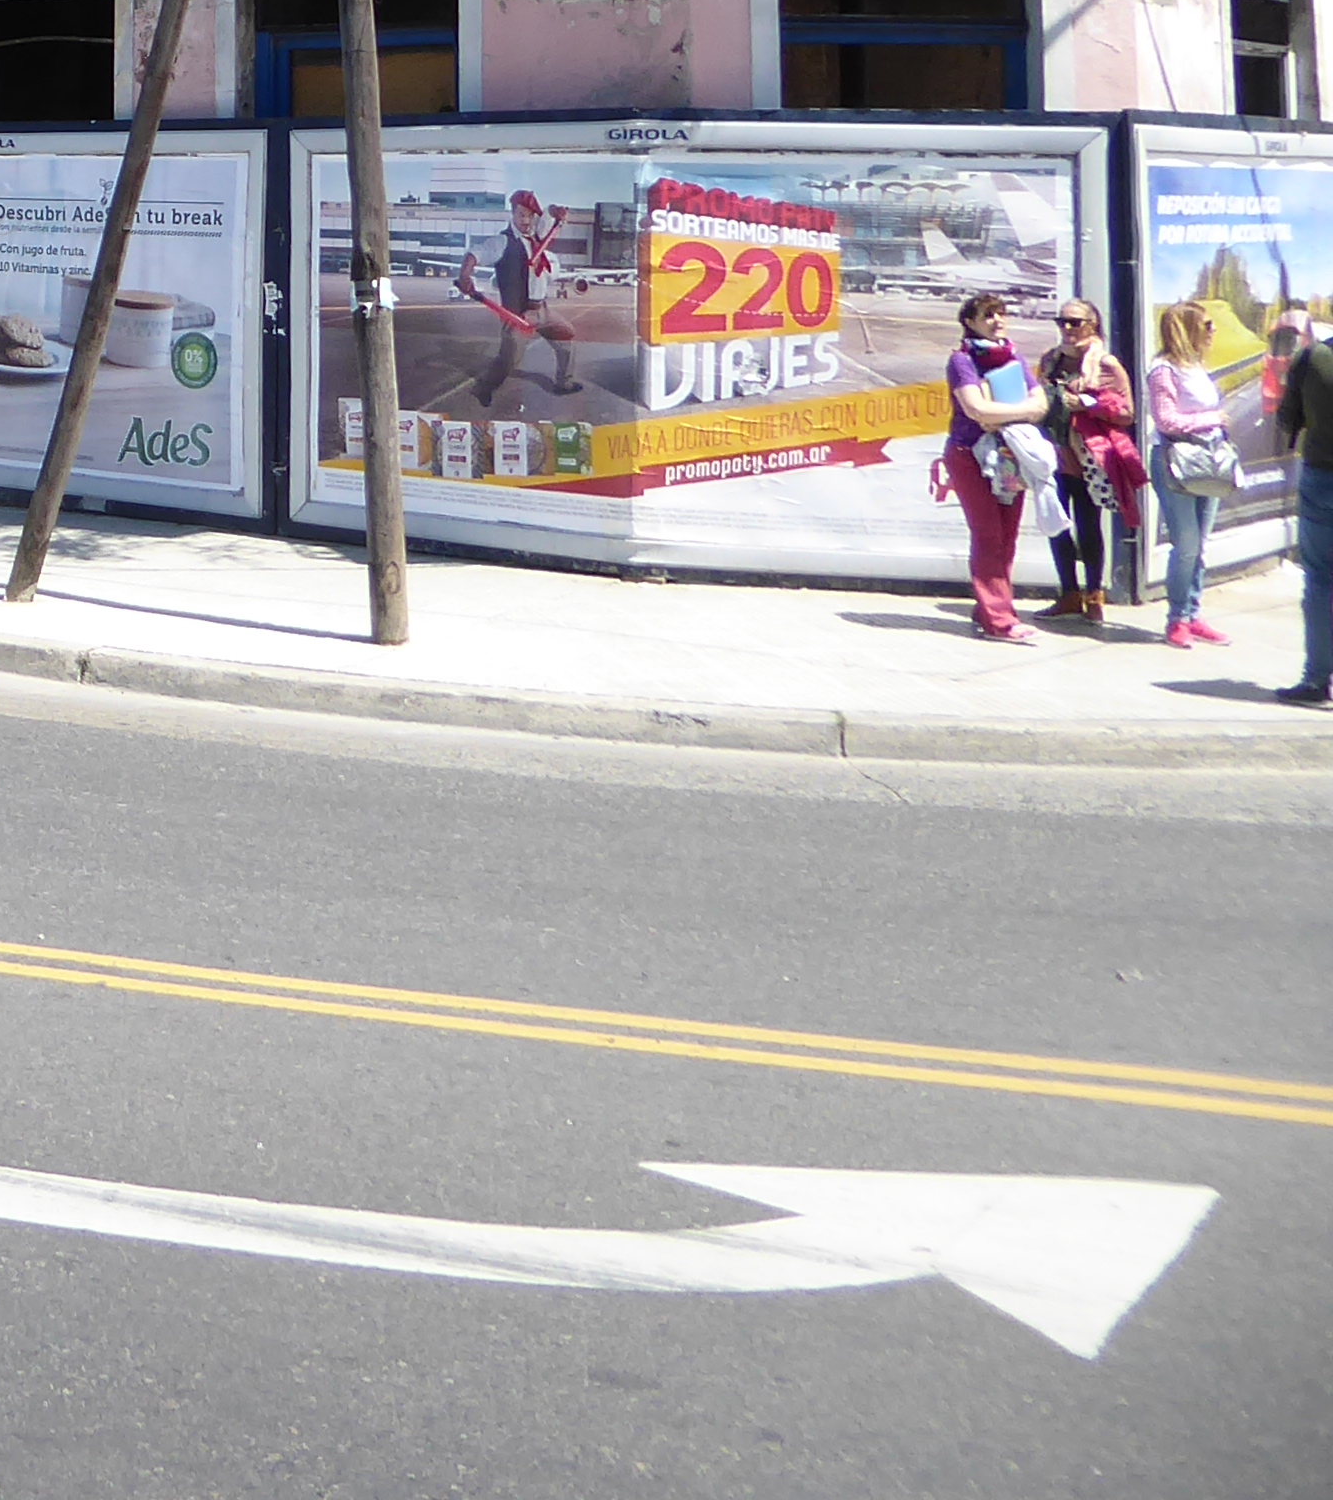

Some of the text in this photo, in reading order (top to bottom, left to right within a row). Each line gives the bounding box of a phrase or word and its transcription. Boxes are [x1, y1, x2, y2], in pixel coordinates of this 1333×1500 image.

[608, 128, 689, 141] GIROLA
[147, 208, 165, 224] tu
[171, 208, 223, 227] break
[650, 178, 773, 224] PROMO
[0, 244, 87, 258] Con jugo de fruta.
[651, 209, 779, 244] SORTEAMOS
[821, 233, 841, 251] DE
[11, 262, 59, 275] Vitaminas
[60, 265, 67, 277] y
[658, 241, 833, 334] 220
[183, 348, 204, 364] 0%
[650, 331, 840, 411] VIAJES
[117, 416, 214, 467] AdeS
[656, 430, 668, 455] A
[673, 420, 733, 452] DONDE
[740, 408, 813, 445] QUIERAS
[820, 401, 858, 428] CON
[864, 392, 919, 428] QUIEN
[665, 444, 832, 486] promopaty.com.ar
